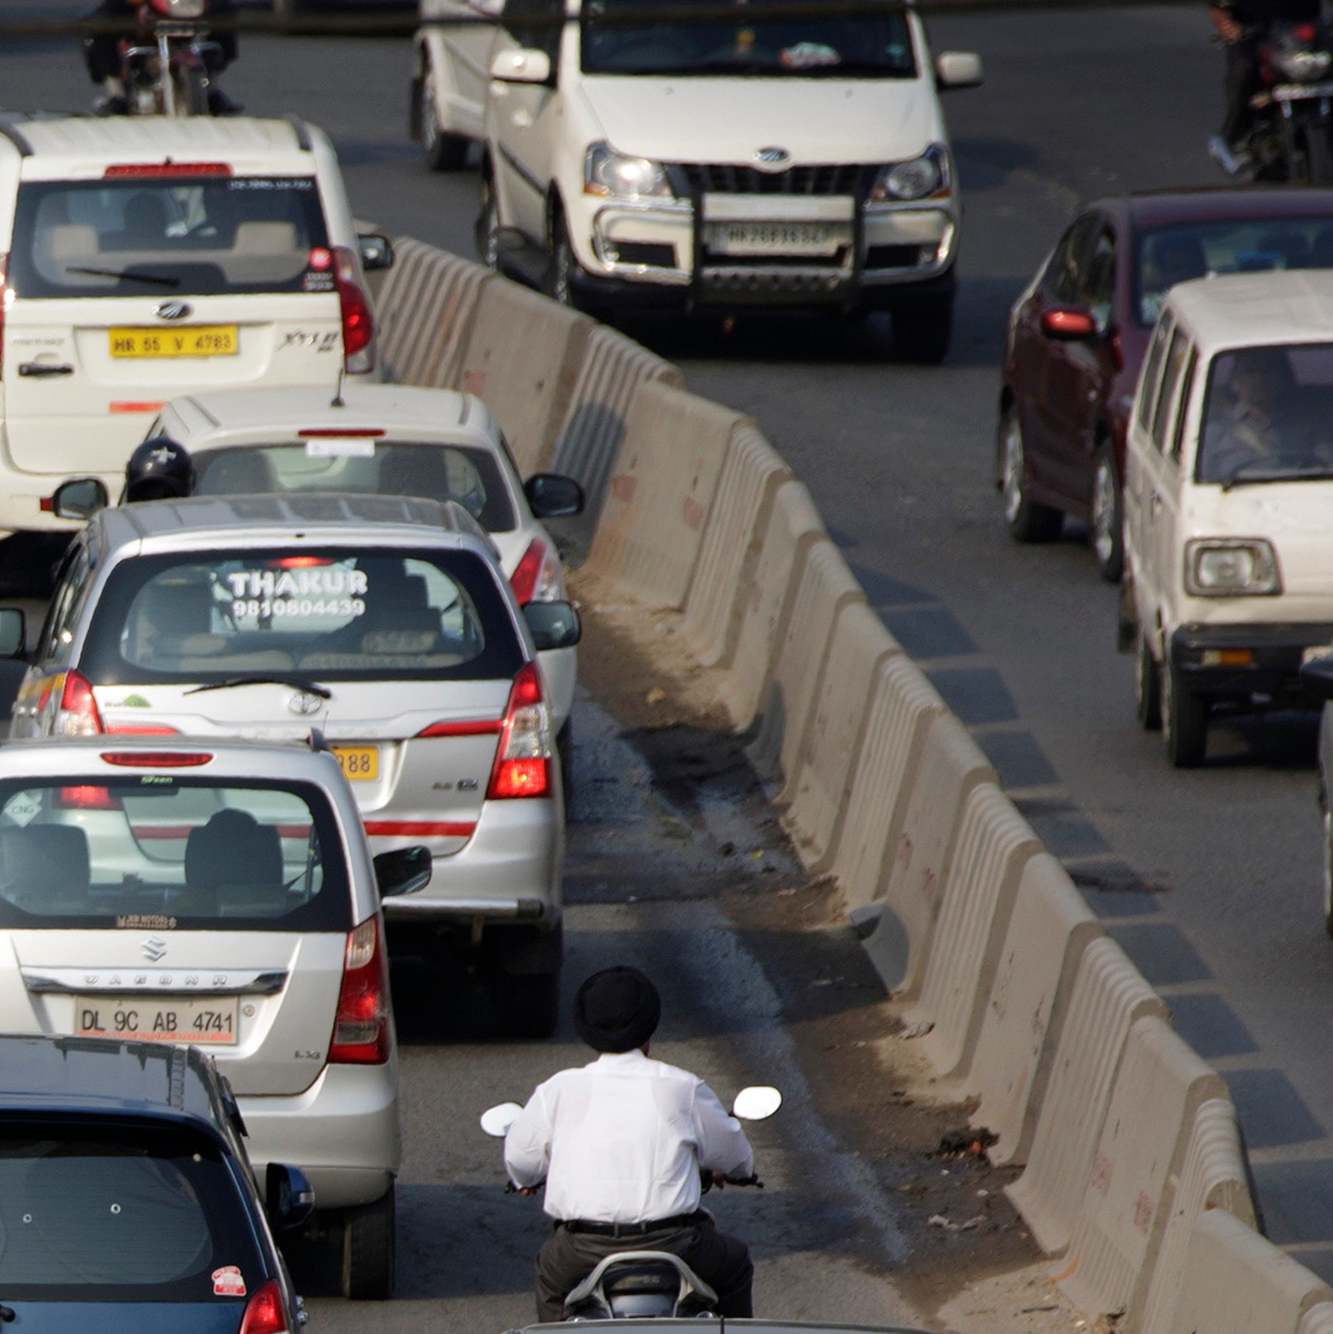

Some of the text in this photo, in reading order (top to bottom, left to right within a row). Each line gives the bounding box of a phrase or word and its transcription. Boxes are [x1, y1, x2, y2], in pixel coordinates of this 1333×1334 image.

[227, 570, 369, 597] THAKUR
[12, 804, 34, 814] CNG
[82, 1011, 233, 1032] DL 9C AB 4741
